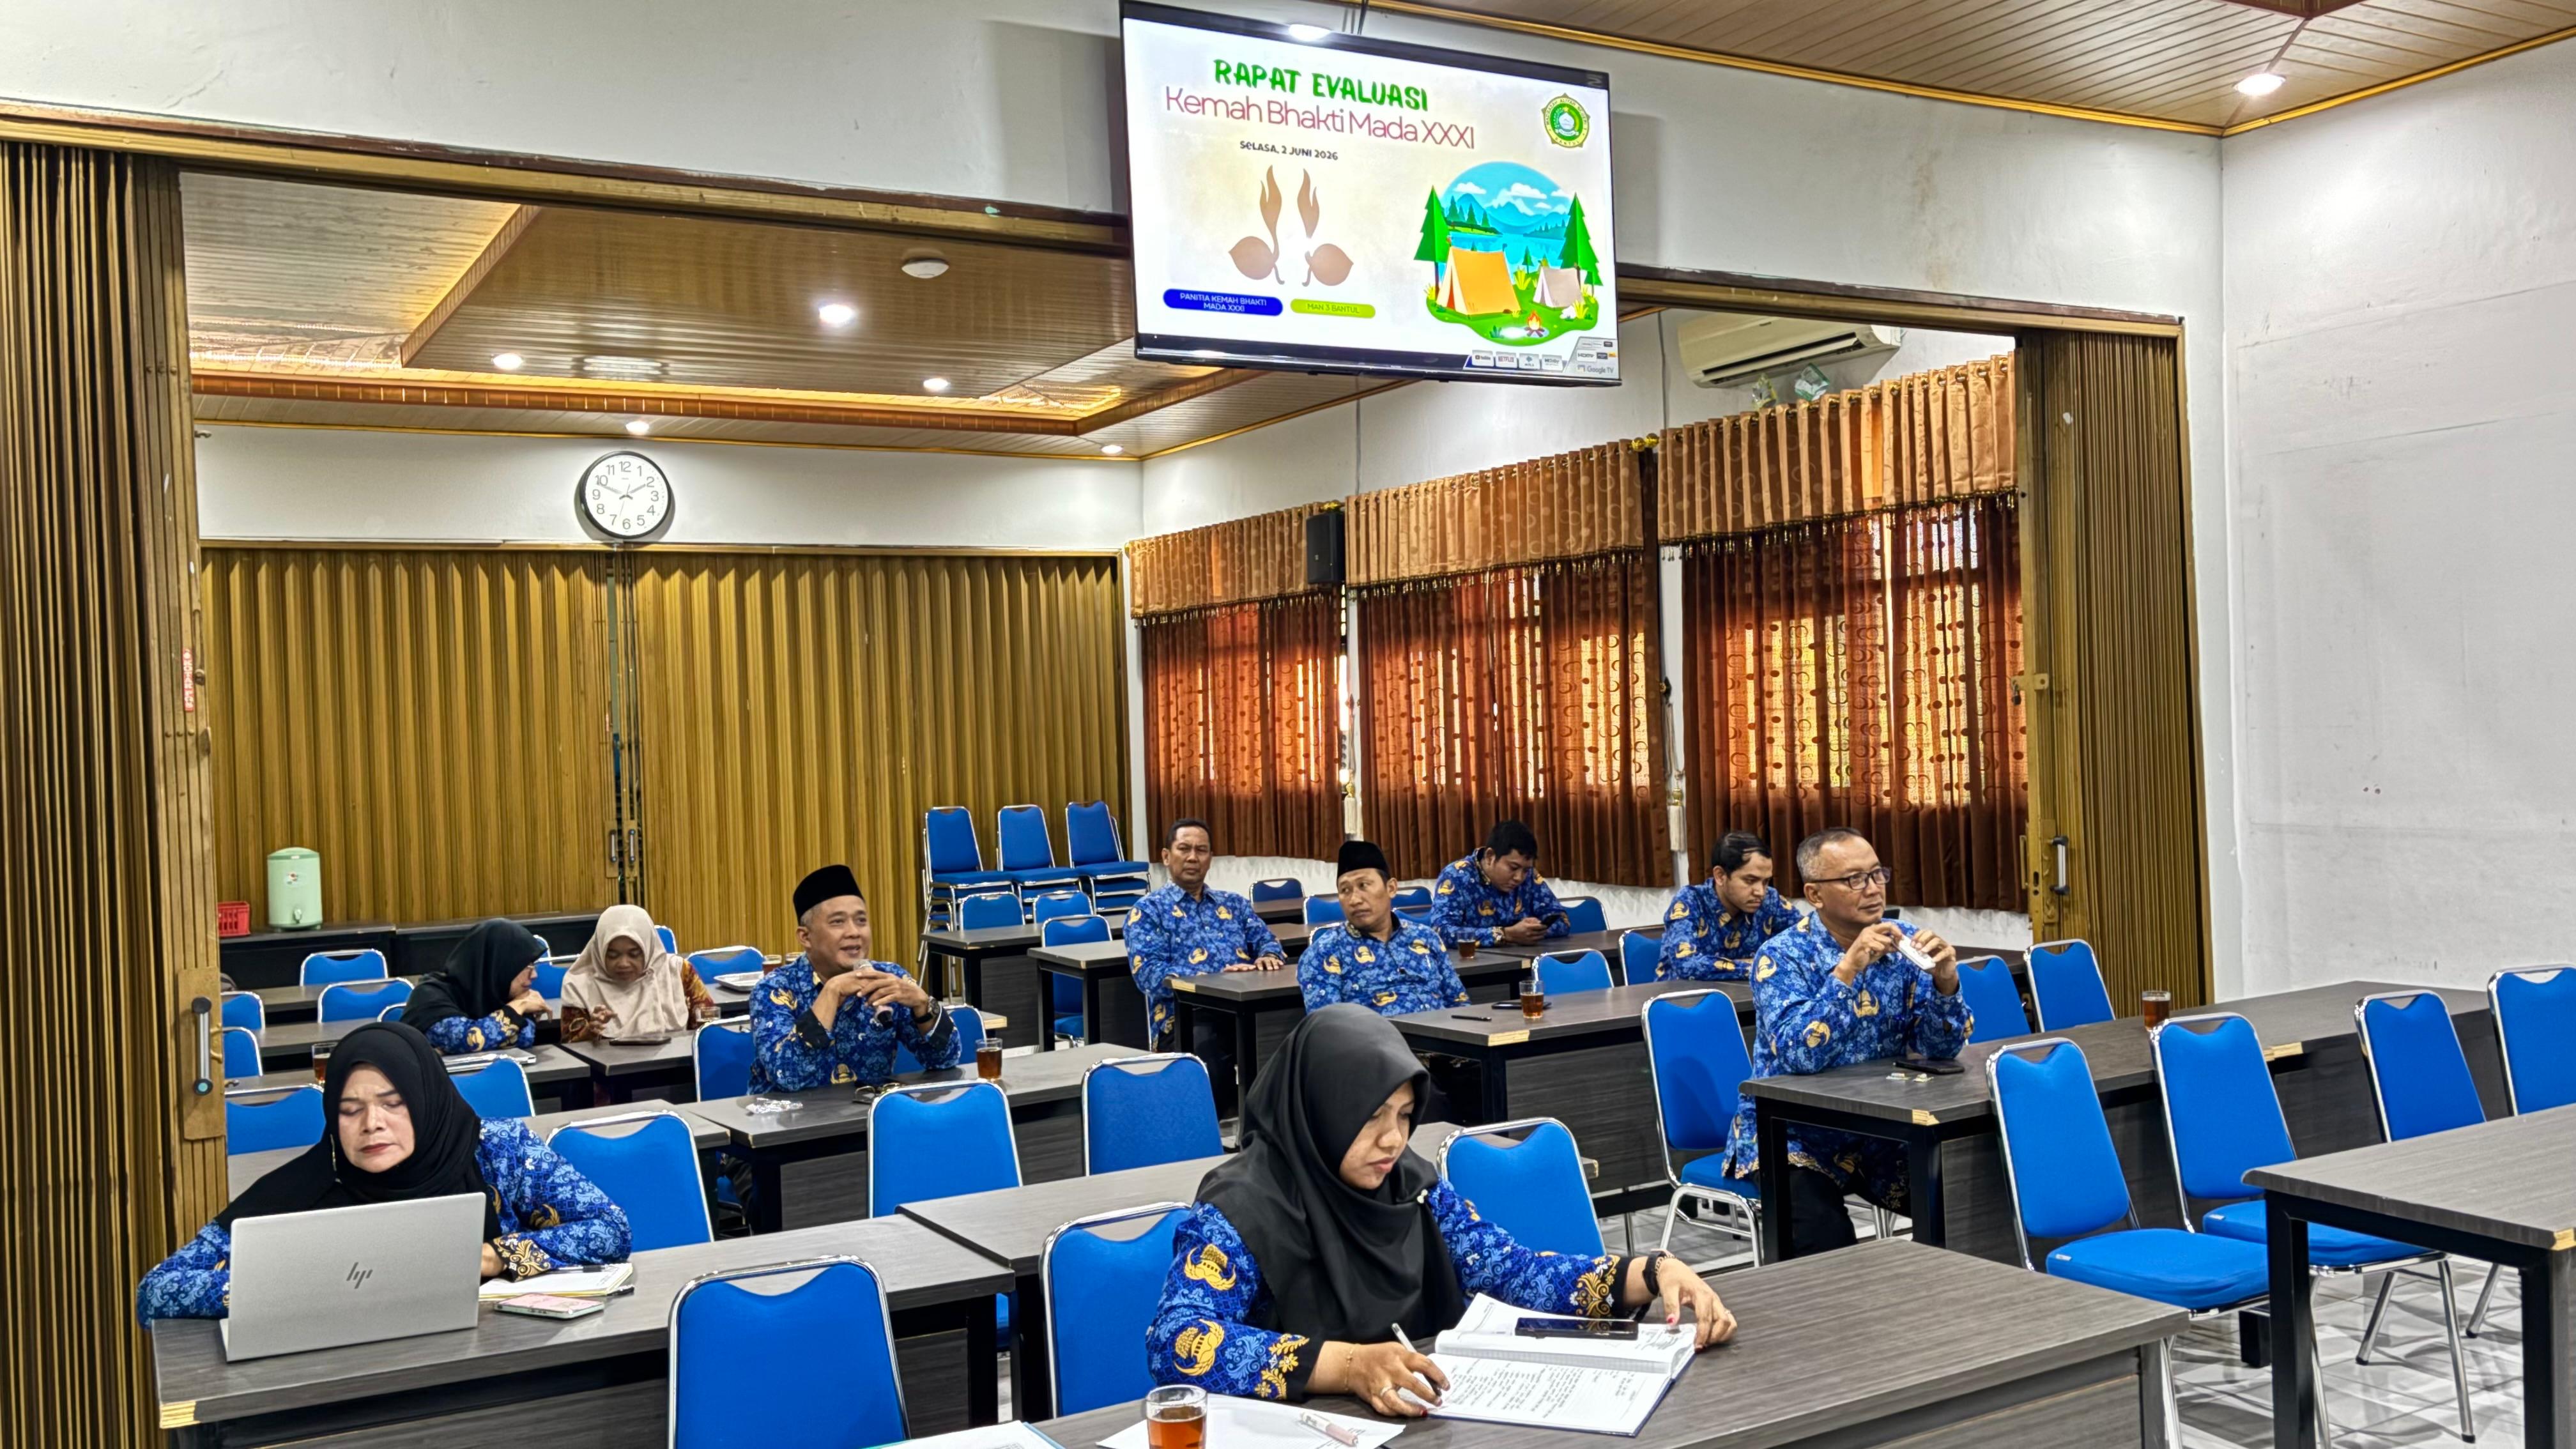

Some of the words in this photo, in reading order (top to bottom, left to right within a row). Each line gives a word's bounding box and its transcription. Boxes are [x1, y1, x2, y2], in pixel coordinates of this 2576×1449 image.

[1213, 59, 1301, 93] RAPAT
[1312, 73, 1428, 112] EVALUASI
[1166, 86, 1263, 123] Kemah
[1268, 100, 1344, 133] Bhakti
[1349, 111, 1418, 142] Mada
[1422, 119, 1475, 150] XXXI
[1281, 145, 1287, 155] 2
[1289, 147, 1312, 157] JUNI
[1314, 149, 1338, 160] 2026
[1180, 293, 1210, 302] PANITIA
[1211, 295, 1238, 303] KEMAH
[1240, 297, 1267, 306] BHAKTI
[1204, 302, 1227, 310] MADA
[1331, 305, 1360, 314] BANTUL
[1587, 365, 1606, 374] Google
[606, 464, 615, 475] 11
[618, 461, 631, 472] 12
[637, 466, 642, 477] 1
[595, 475, 608, 486] 10
[646, 476, 655, 487] 2
[592, 489, 601, 500] 9
[650, 491, 659, 502] 3
[596, 503, 605, 514] 8
[647, 505, 656, 516] 4
[610, 514, 617, 526] 7
[622, 518, 631, 530] 6
[636, 515, 645, 526] 5
[346, 1262, 373, 1289] hp
